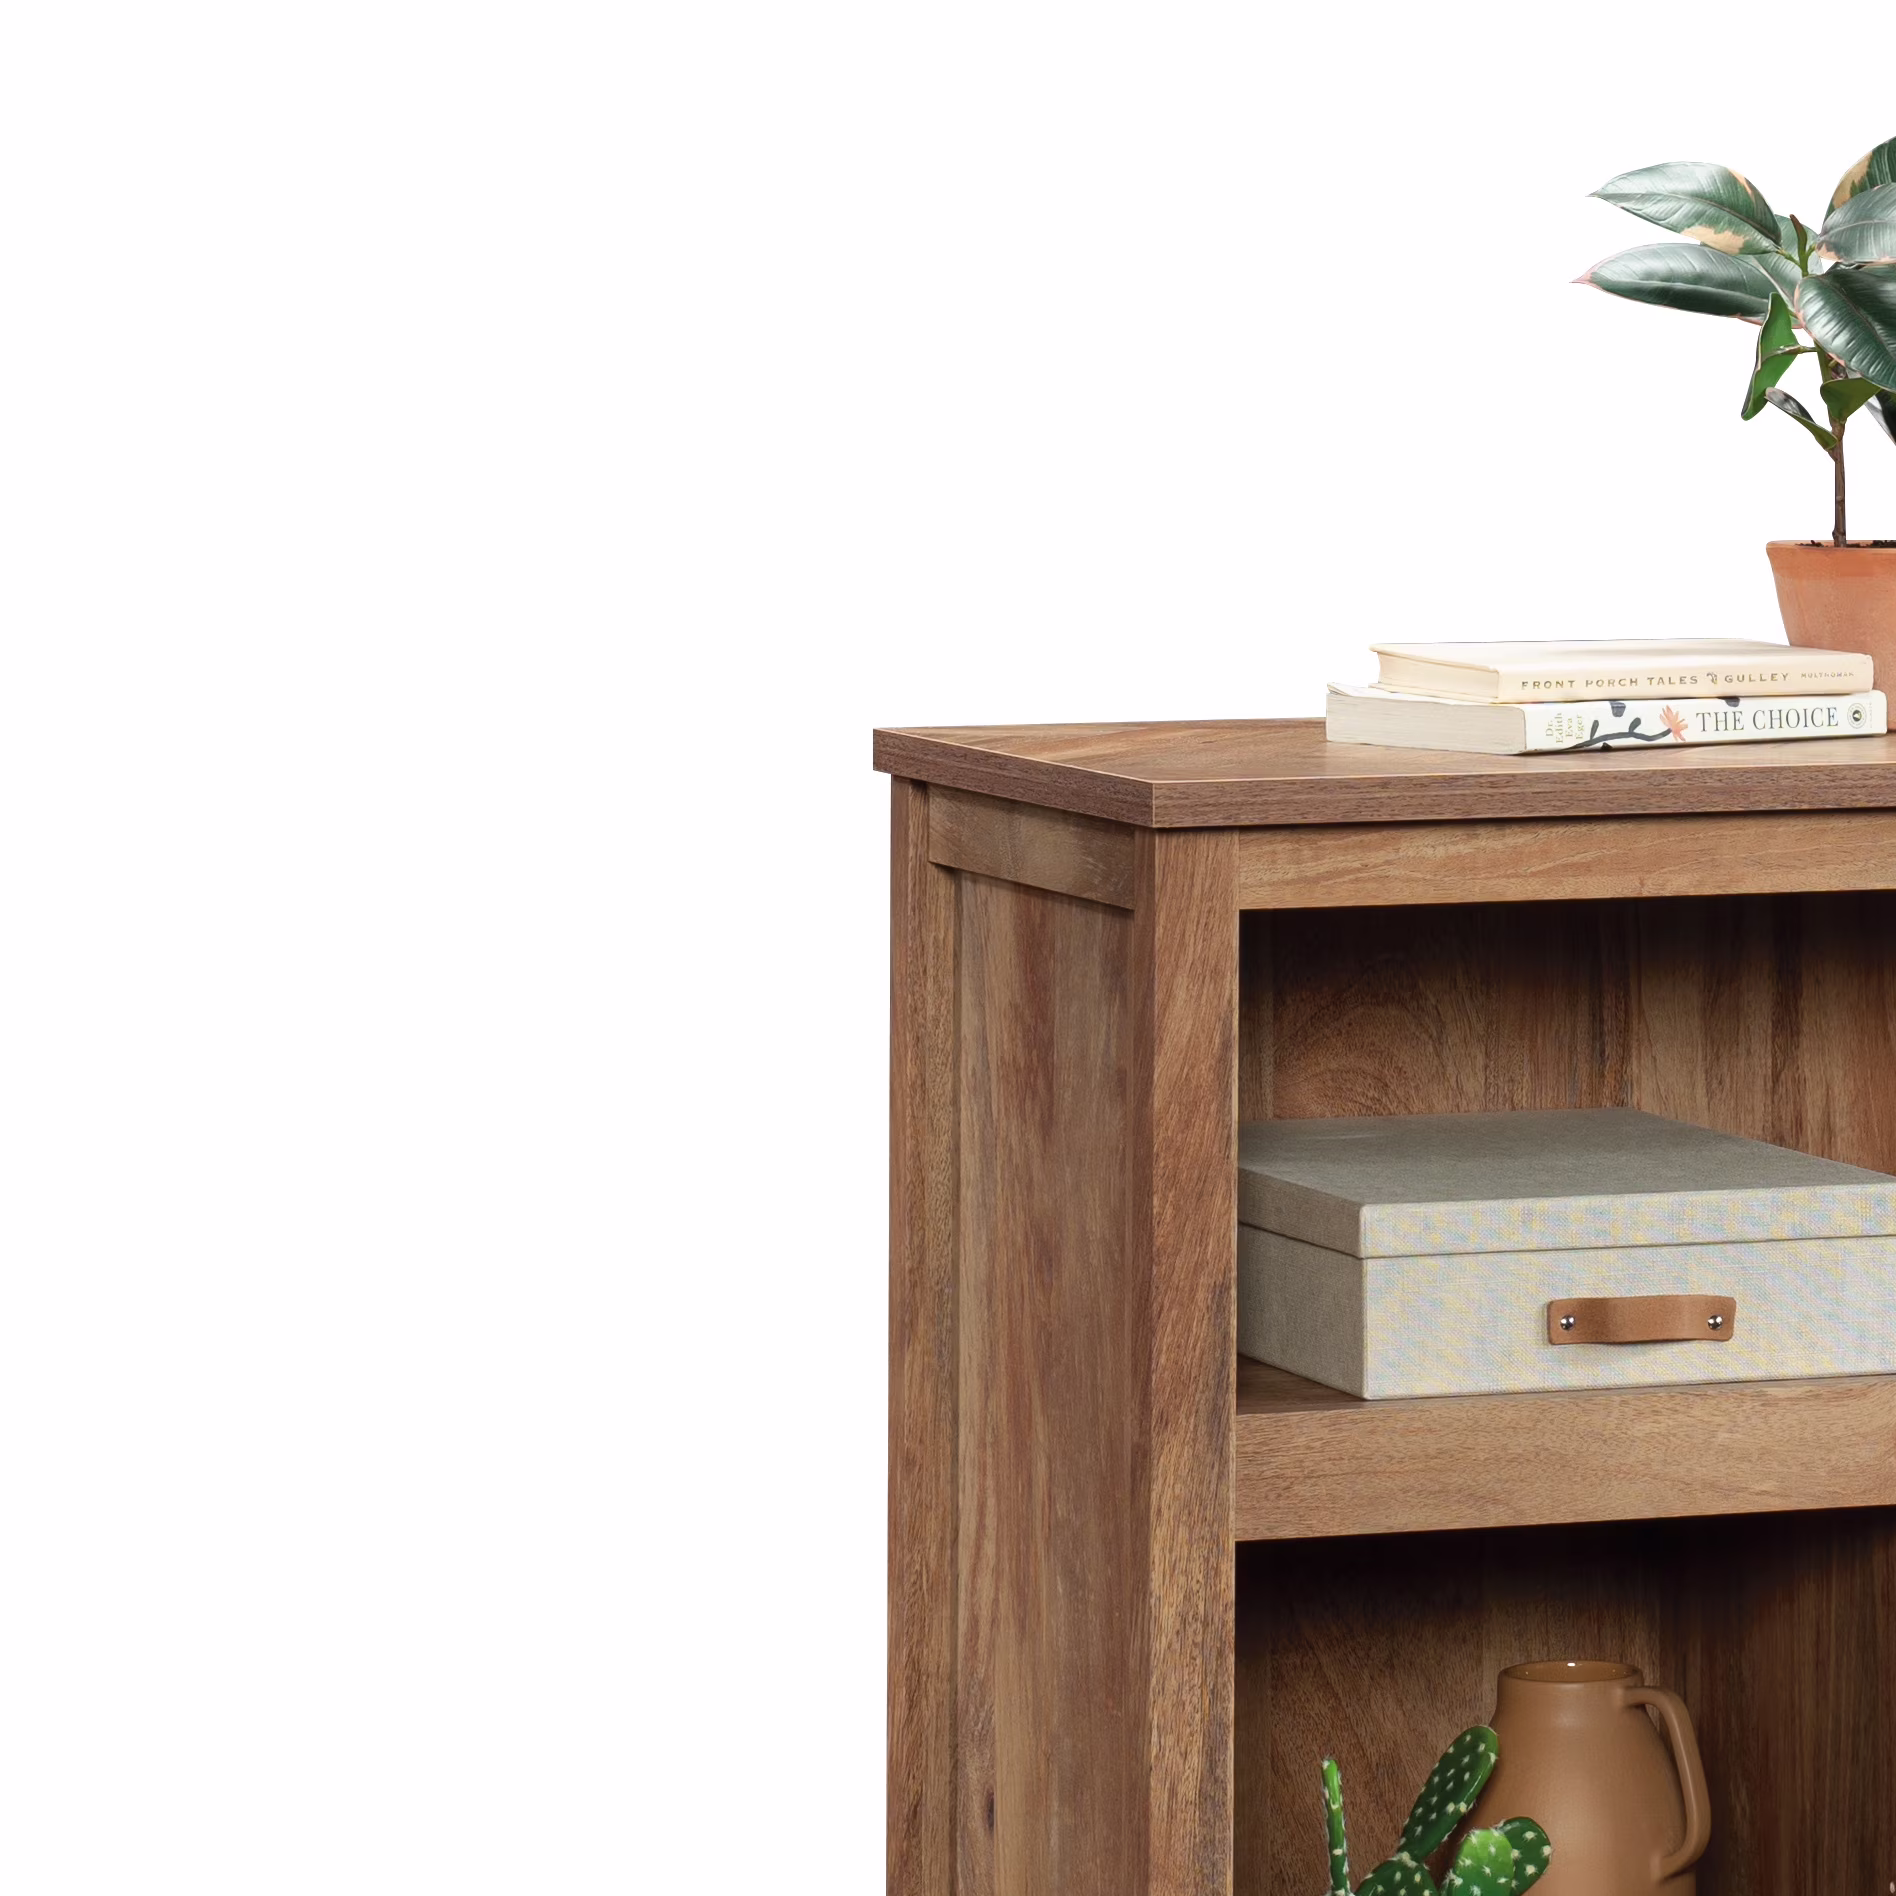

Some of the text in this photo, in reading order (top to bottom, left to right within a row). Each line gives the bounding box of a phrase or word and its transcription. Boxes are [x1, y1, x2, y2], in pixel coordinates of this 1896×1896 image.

[1521, 680, 1576, 690] FRONT
[1586, 678, 1638, 688] PORCH
[1647, 675, 1698, 685] TALES
[1724, 673, 1789, 683] GULLEY
[1555, 712, 1564, 744] Edith
[1565, 718, 1573, 738] Eva
[1575, 715, 1585, 740] Eger
[1696, 710, 1745, 732] THE
[1752, 707, 1839, 730] CHOICE
